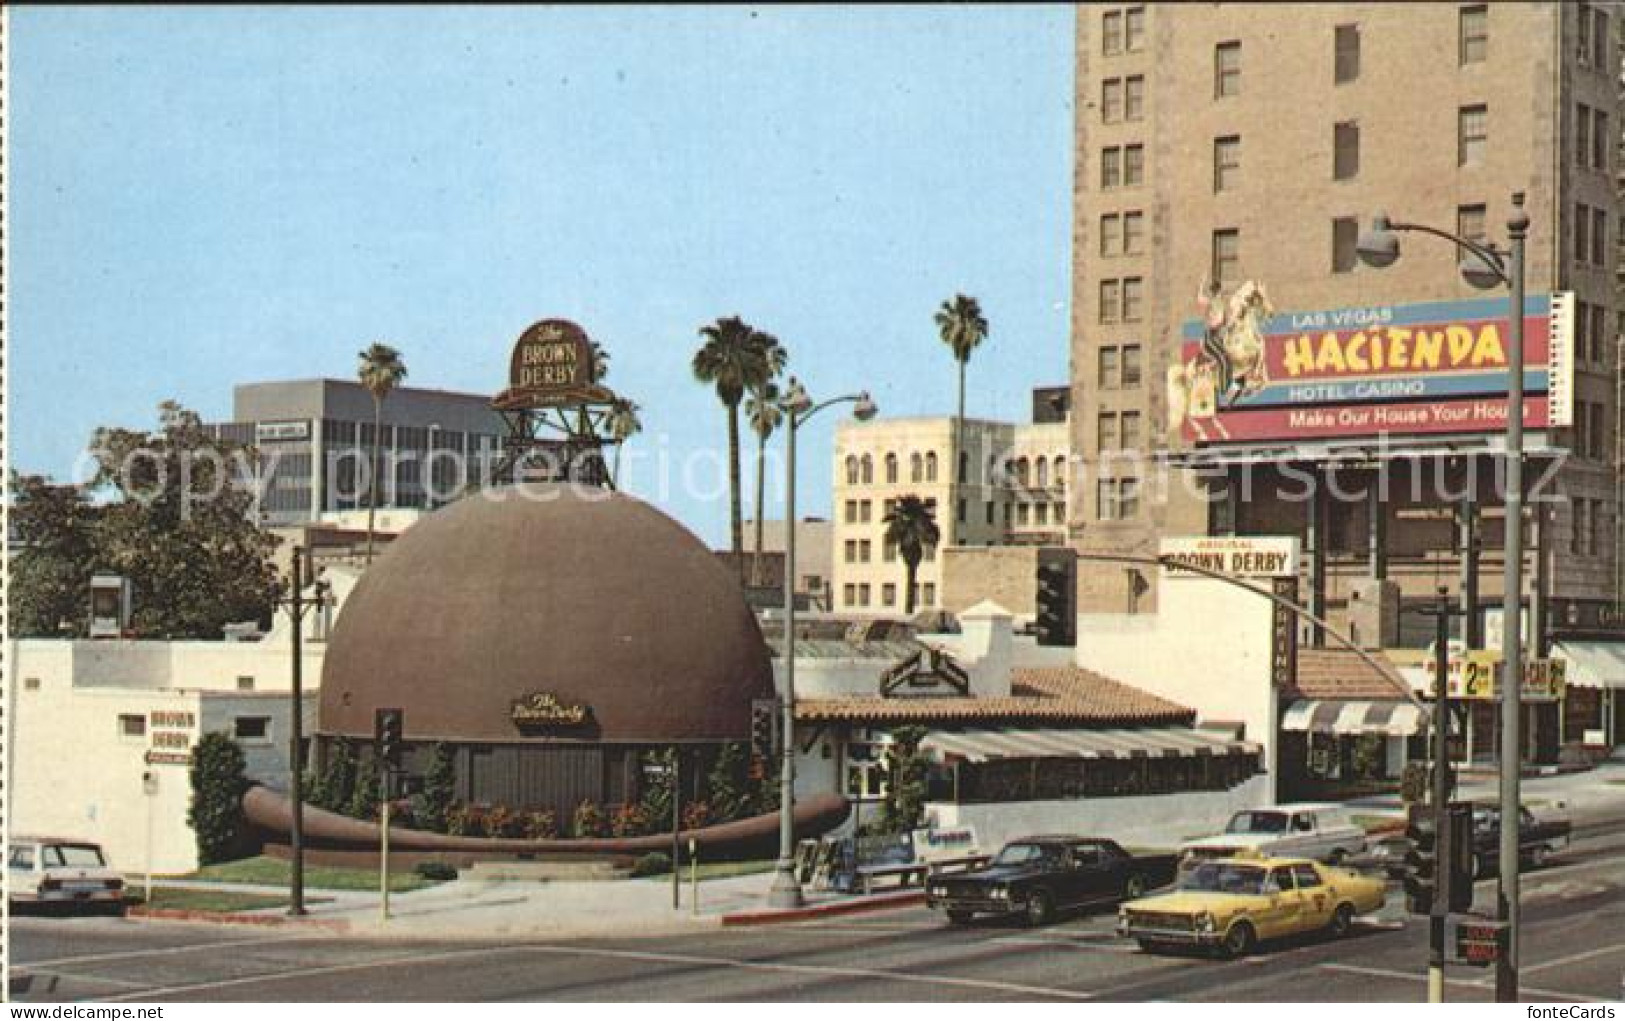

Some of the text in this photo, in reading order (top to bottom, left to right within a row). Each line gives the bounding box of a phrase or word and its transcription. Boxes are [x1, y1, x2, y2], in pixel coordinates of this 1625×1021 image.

[1292, 306, 1393, 328] LAS VEGAS
[522, 341, 577, 363] BROWN
[520, 365, 576, 386] DERBY
[1290, 380, 1425, 401] HOTEL CASINO
[1289, 401, 1529, 427] Make Our House Your Houe
[1232, 551, 1288, 572] DERBY
